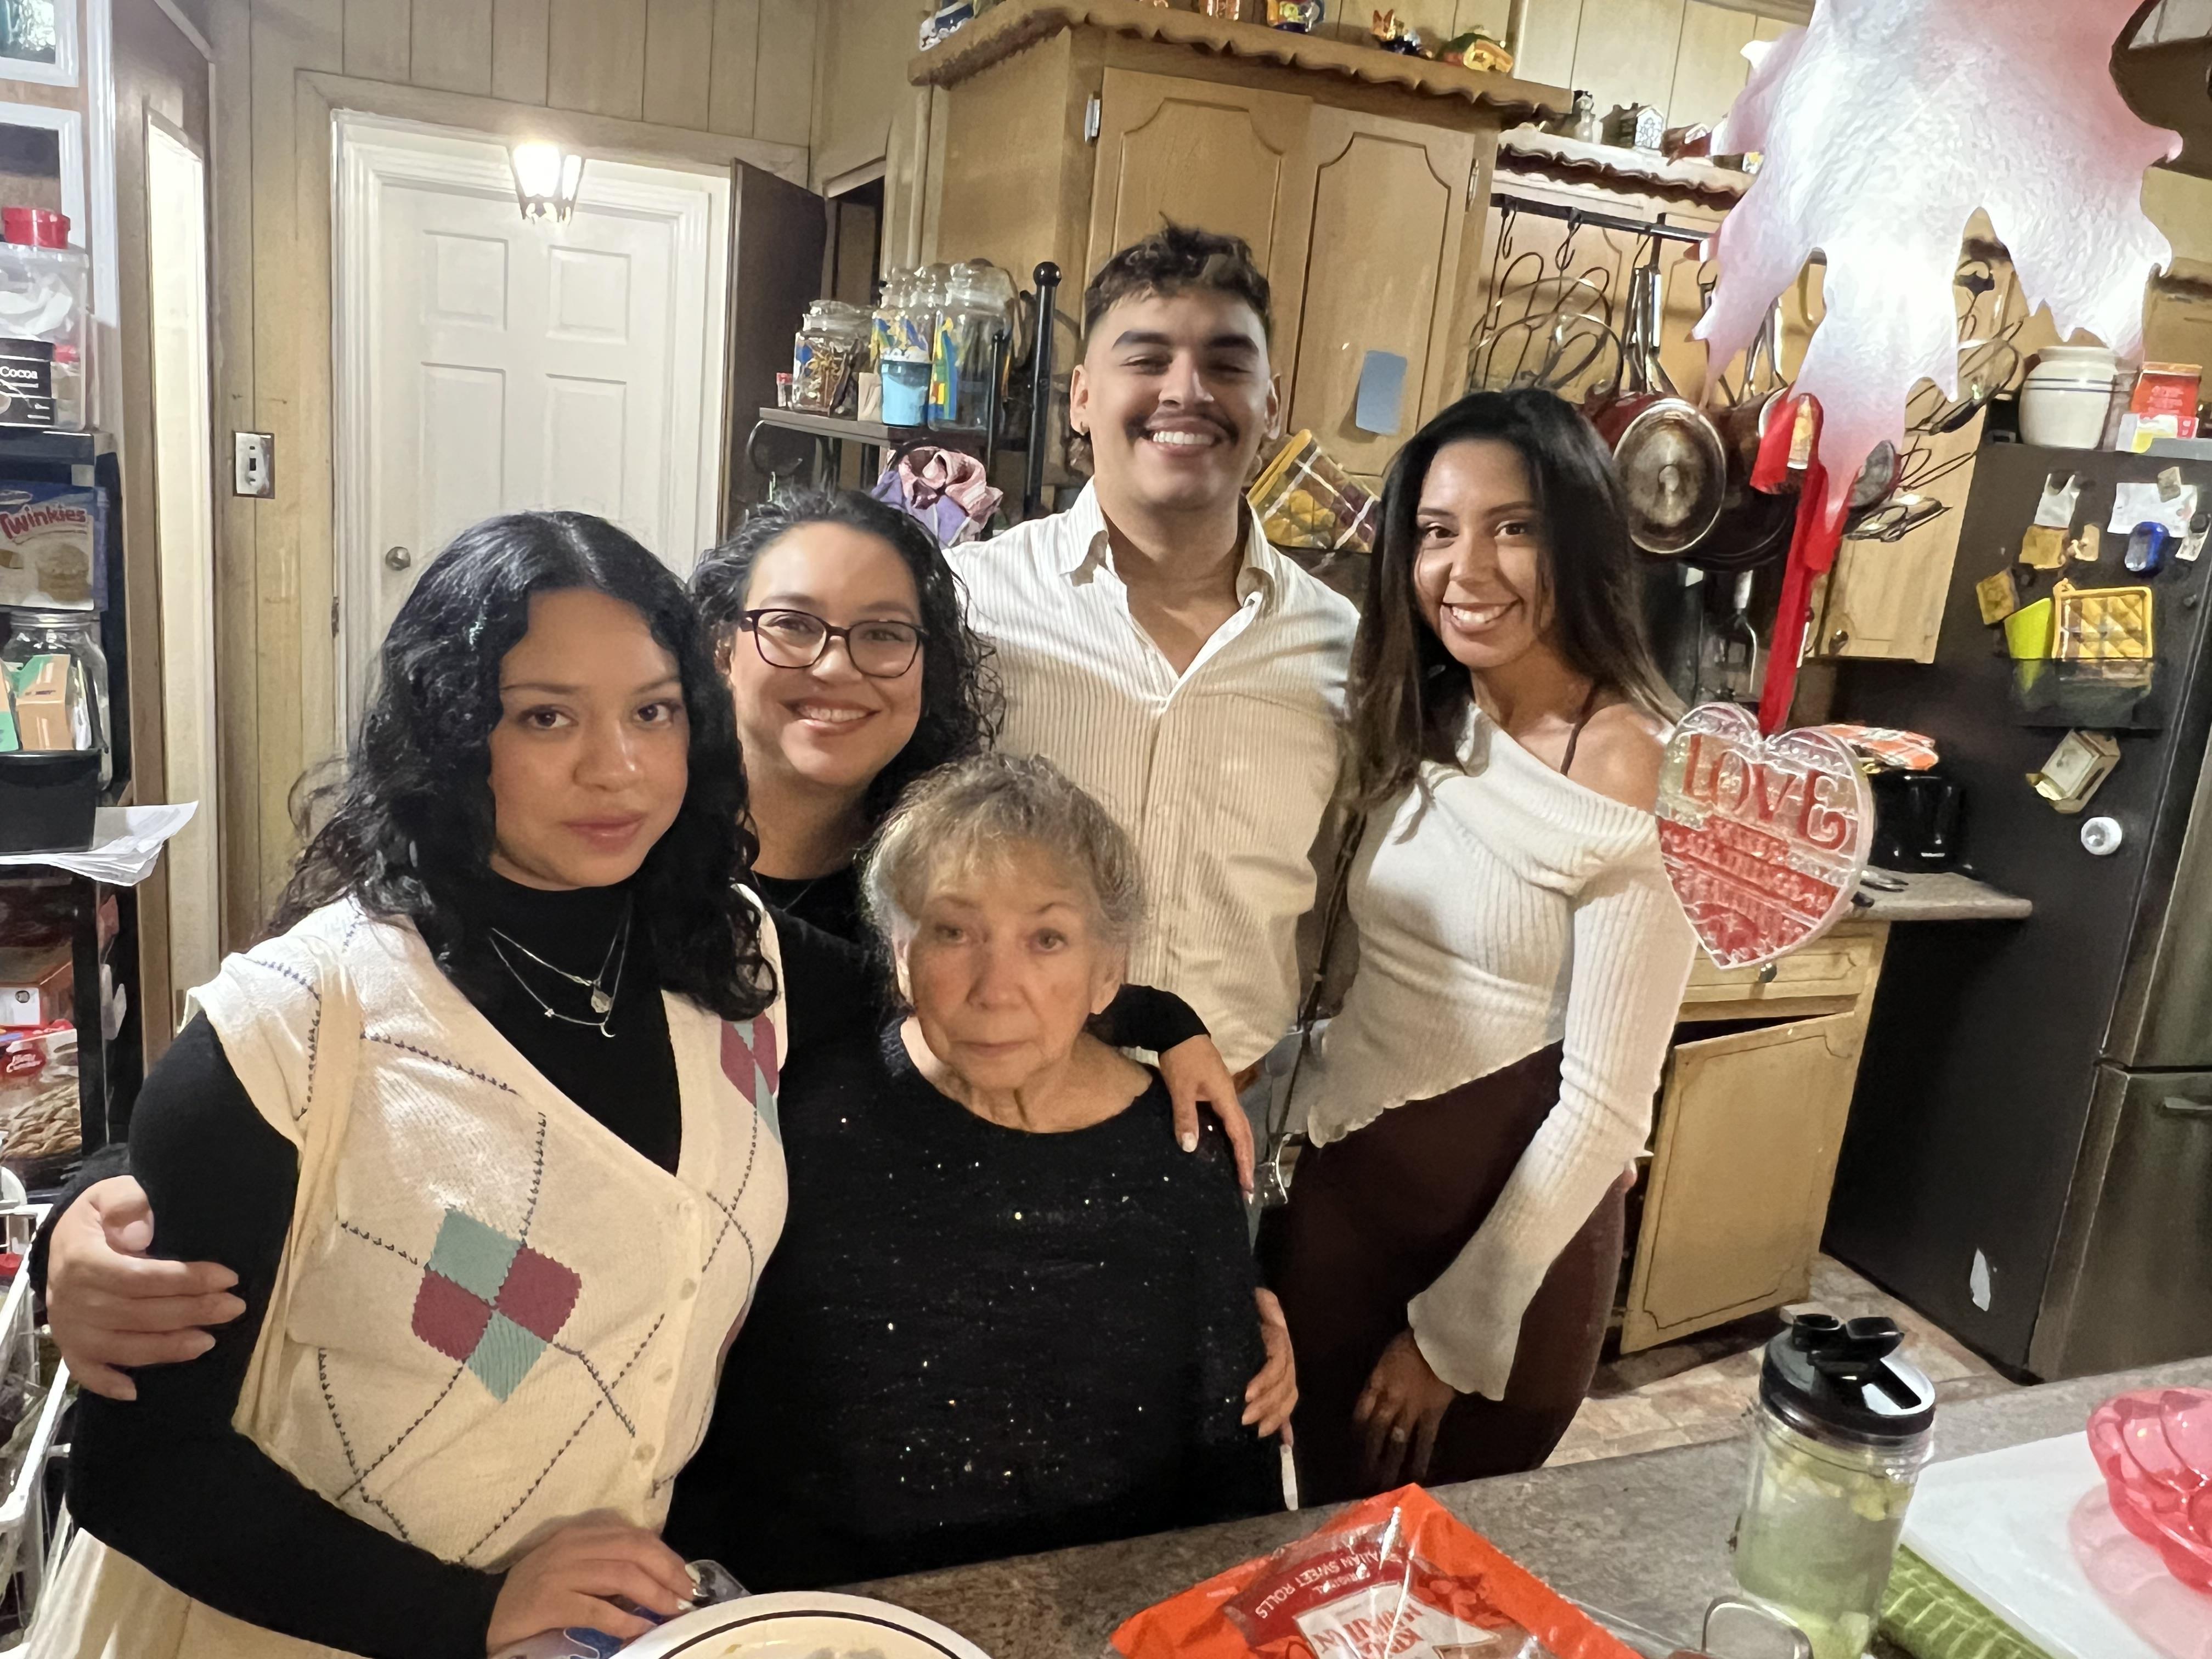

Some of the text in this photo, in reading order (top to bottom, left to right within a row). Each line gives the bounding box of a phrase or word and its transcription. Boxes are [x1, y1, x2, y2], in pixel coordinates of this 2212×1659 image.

[0, 366, 38, 379] Cocoa
[0, 504, 86, 539] Twinkies
[1681, 733, 1851, 851] LOVE
[1295, 1561, 1340, 1587] SWEET
[1255, 1583, 1296, 1618] ROLLS
